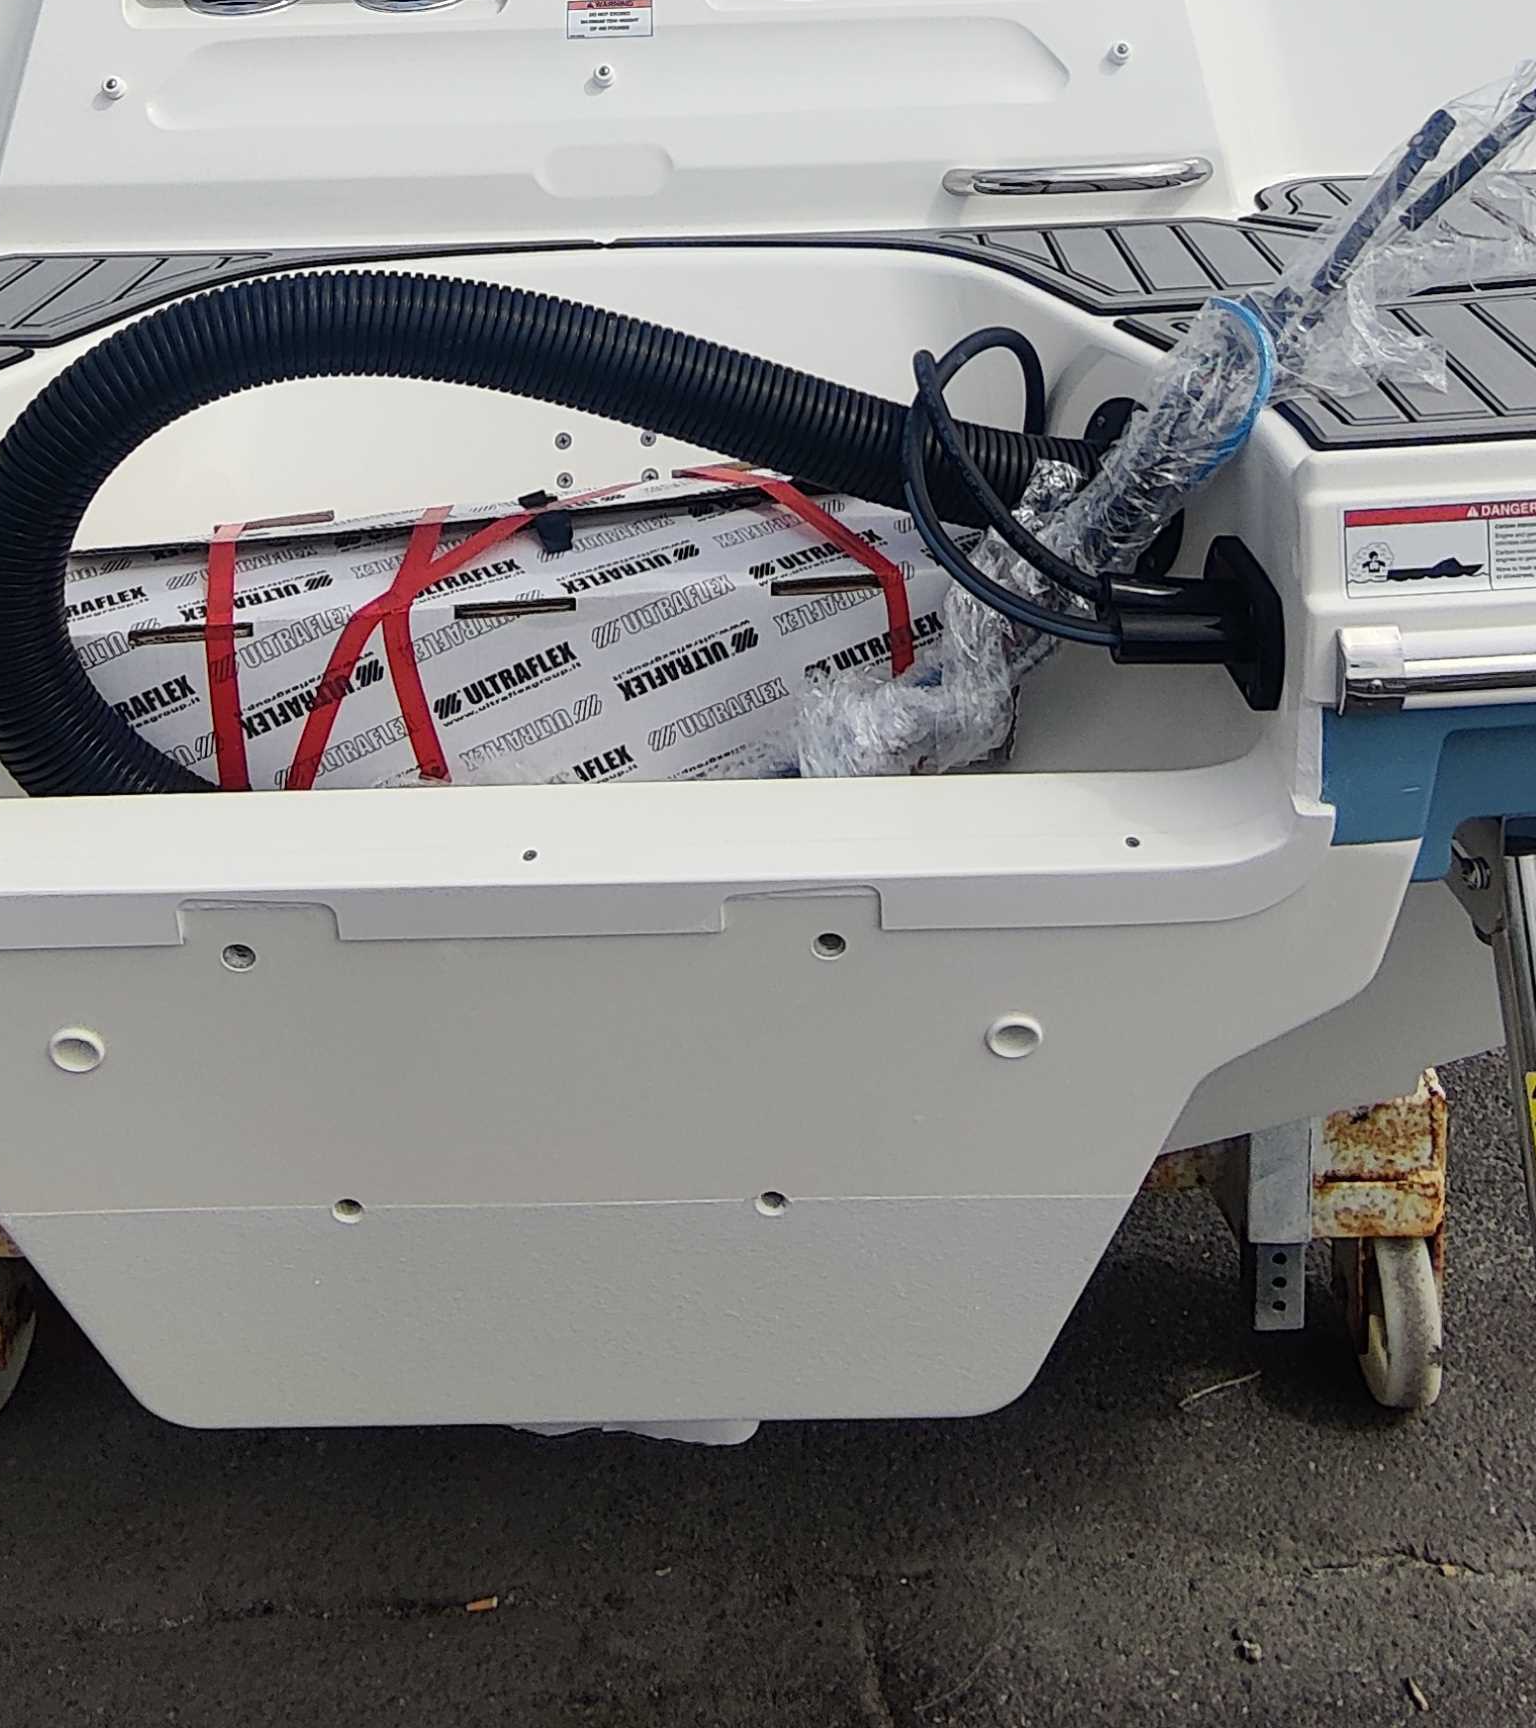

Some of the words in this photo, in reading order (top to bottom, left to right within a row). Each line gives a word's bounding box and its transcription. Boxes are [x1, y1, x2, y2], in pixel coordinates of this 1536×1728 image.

[562, 553, 673, 595] ULTRAFLEX
[776, 529, 884, 571] ULTRAEX
[64, 586, 147, 619] RAFLEX
[180, 583, 302, 622] ULTRAEX
[623, 574, 736, 634] ULTRAFLEX
[464, 641, 578, 704] ULTRAFLEX
[617, 641, 729, 701] ULTRAFLEX
[111, 674, 196, 723] RAFLEX
[677, 677, 790, 737] ULTRAFLEX
[319, 715, 412, 776] LTRAFLE
[459, 708, 574, 771] ULTRAFLEX
[573, 744, 635, 781] AFLEX
